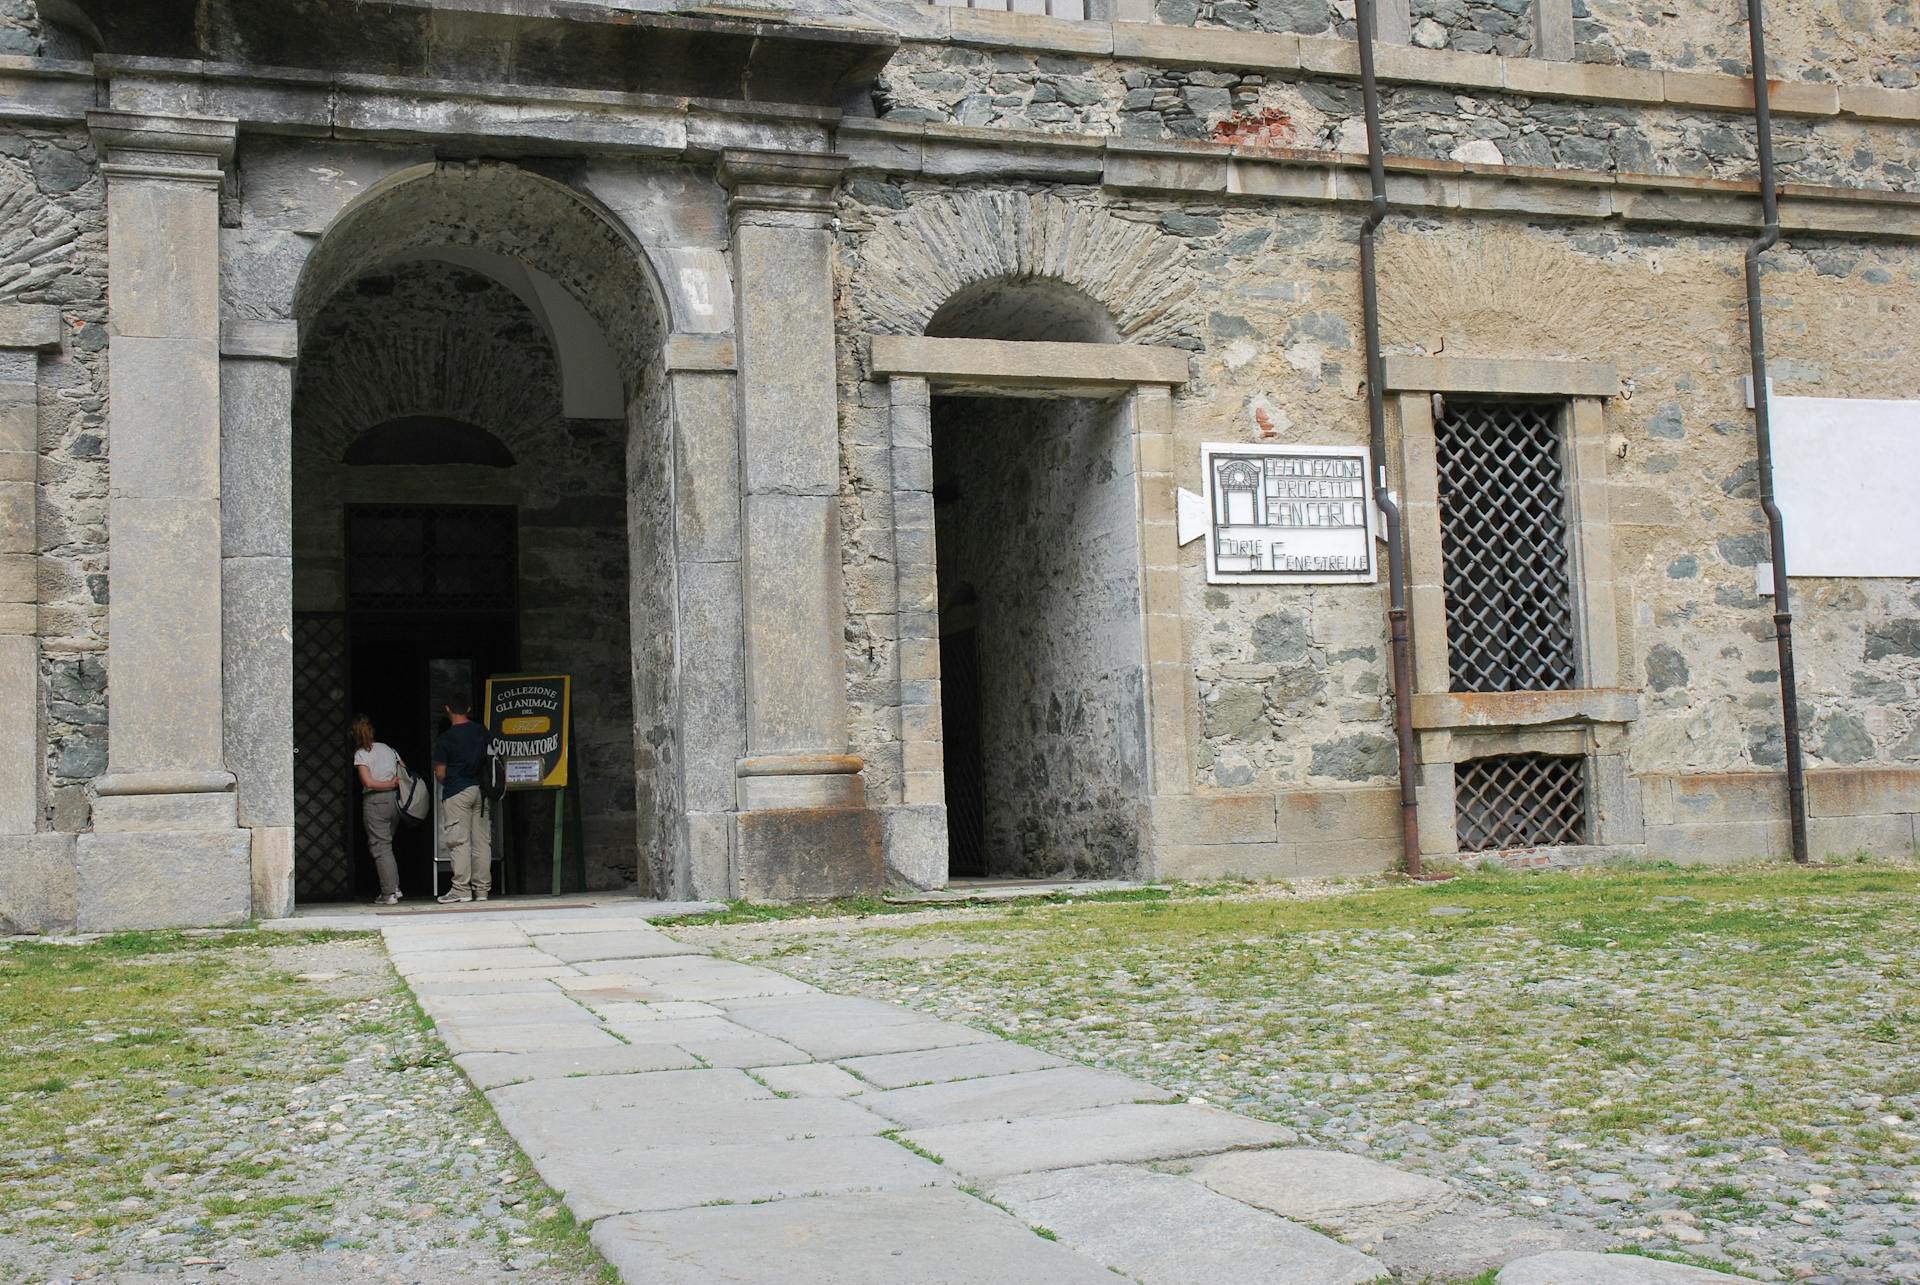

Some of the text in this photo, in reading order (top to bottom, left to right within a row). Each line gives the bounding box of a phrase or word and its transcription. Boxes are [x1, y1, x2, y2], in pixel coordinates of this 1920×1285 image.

[1265, 458, 1360, 477] ASSOCIAZIONE
[1277, 479, 1353, 498] PROGETTO
[1267, 502, 1363, 526] SAN CARLO
[1217, 526, 1264, 556] FORTE
[1250, 541, 1368, 571] DI FENESTRELLE
[497, 686, 558, 701] COLLEZIONE
[495, 698, 558, 713] GLI ANIMALI
[492, 733, 559, 757] GOVERNATORE
